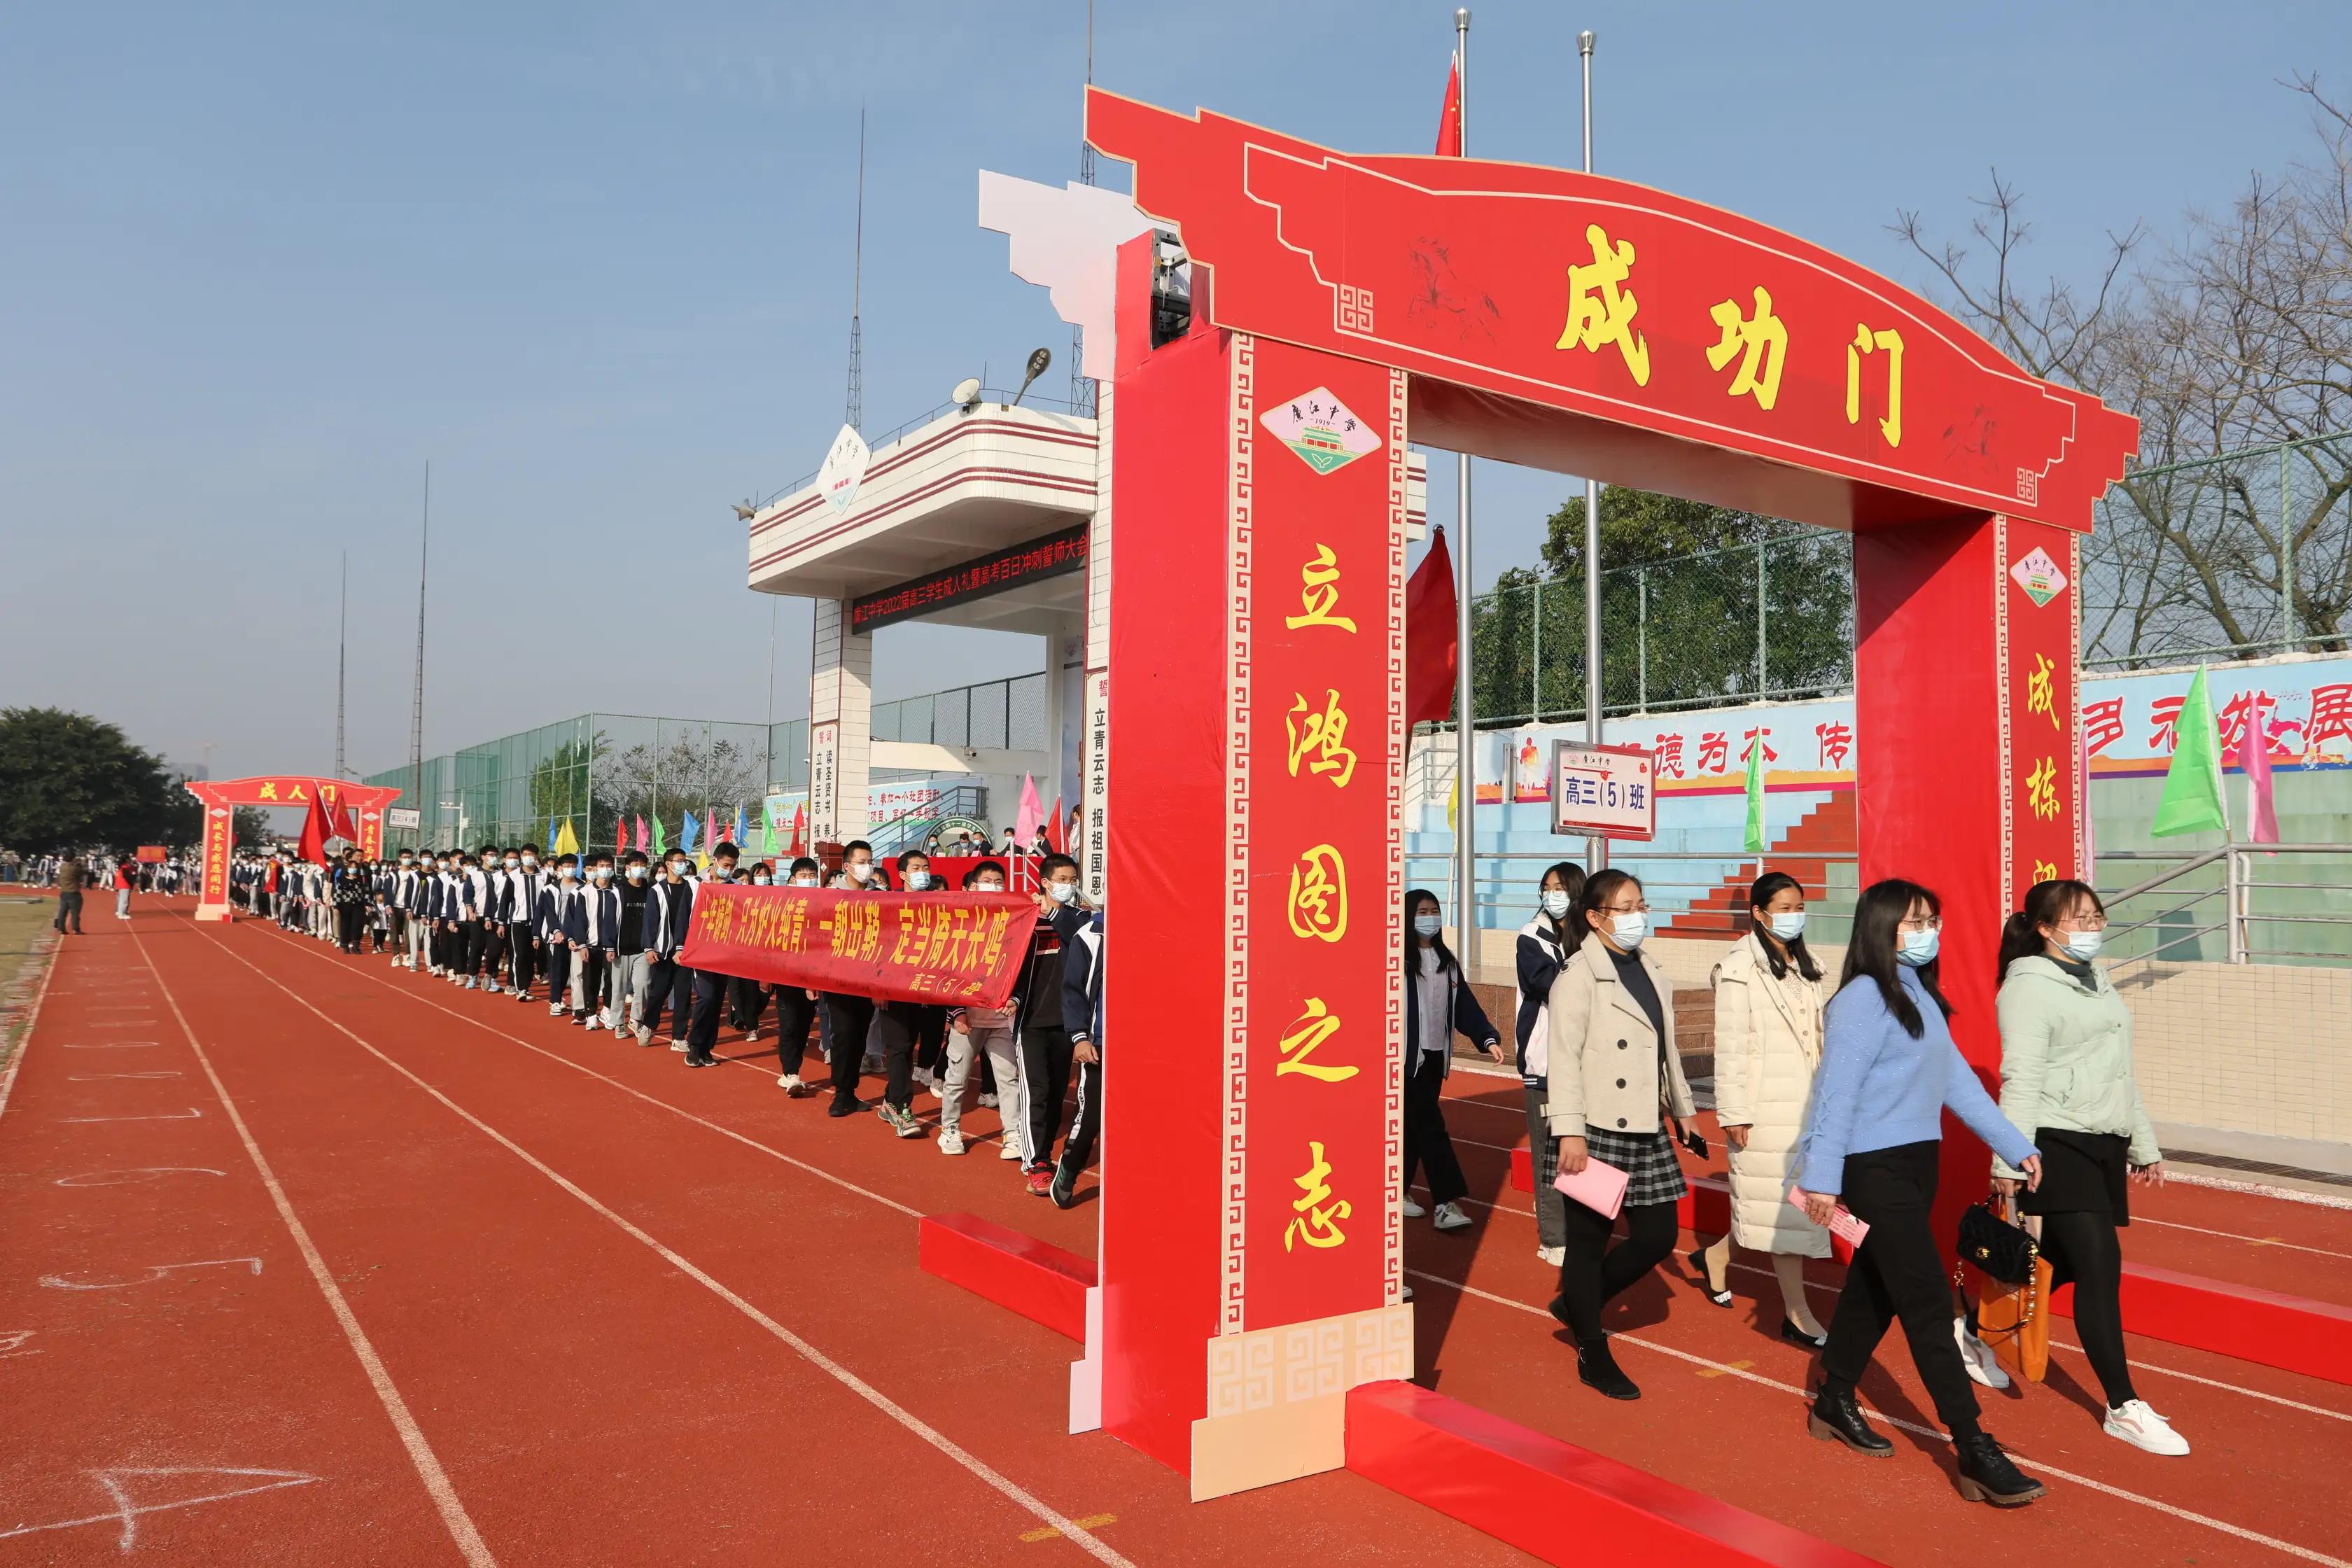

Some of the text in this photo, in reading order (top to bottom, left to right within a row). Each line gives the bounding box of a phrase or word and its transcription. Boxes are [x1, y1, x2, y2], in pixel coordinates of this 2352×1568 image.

[1555, 223, 1905, 449] 成功门
[1275, 543, 1360, 1253] 立鸿图之志
